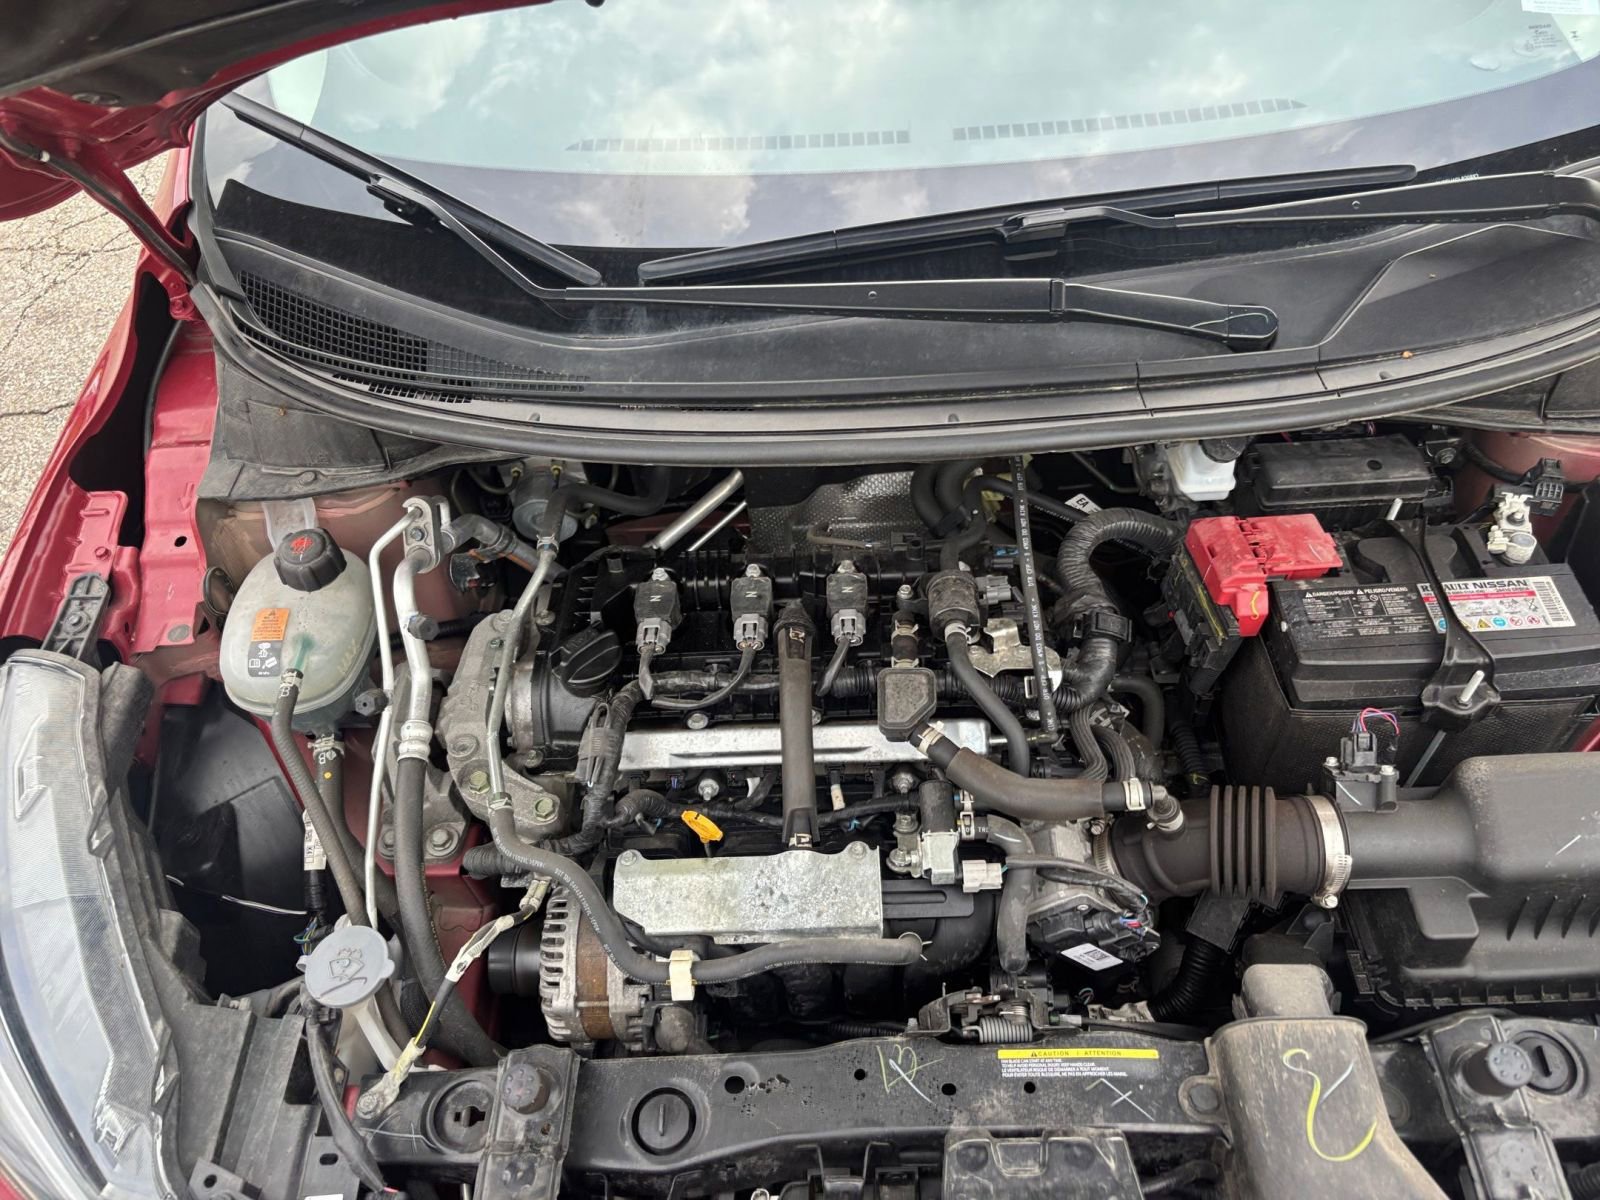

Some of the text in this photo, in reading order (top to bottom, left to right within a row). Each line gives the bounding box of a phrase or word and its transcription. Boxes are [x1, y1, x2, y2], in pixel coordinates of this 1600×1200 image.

[1076, 497, 1089, 509] EA
[1472, 580, 1528, 589] NISSAN
[1031, 604, 1039, 618] KINK
[1035, 632, 1042, 641] DO
